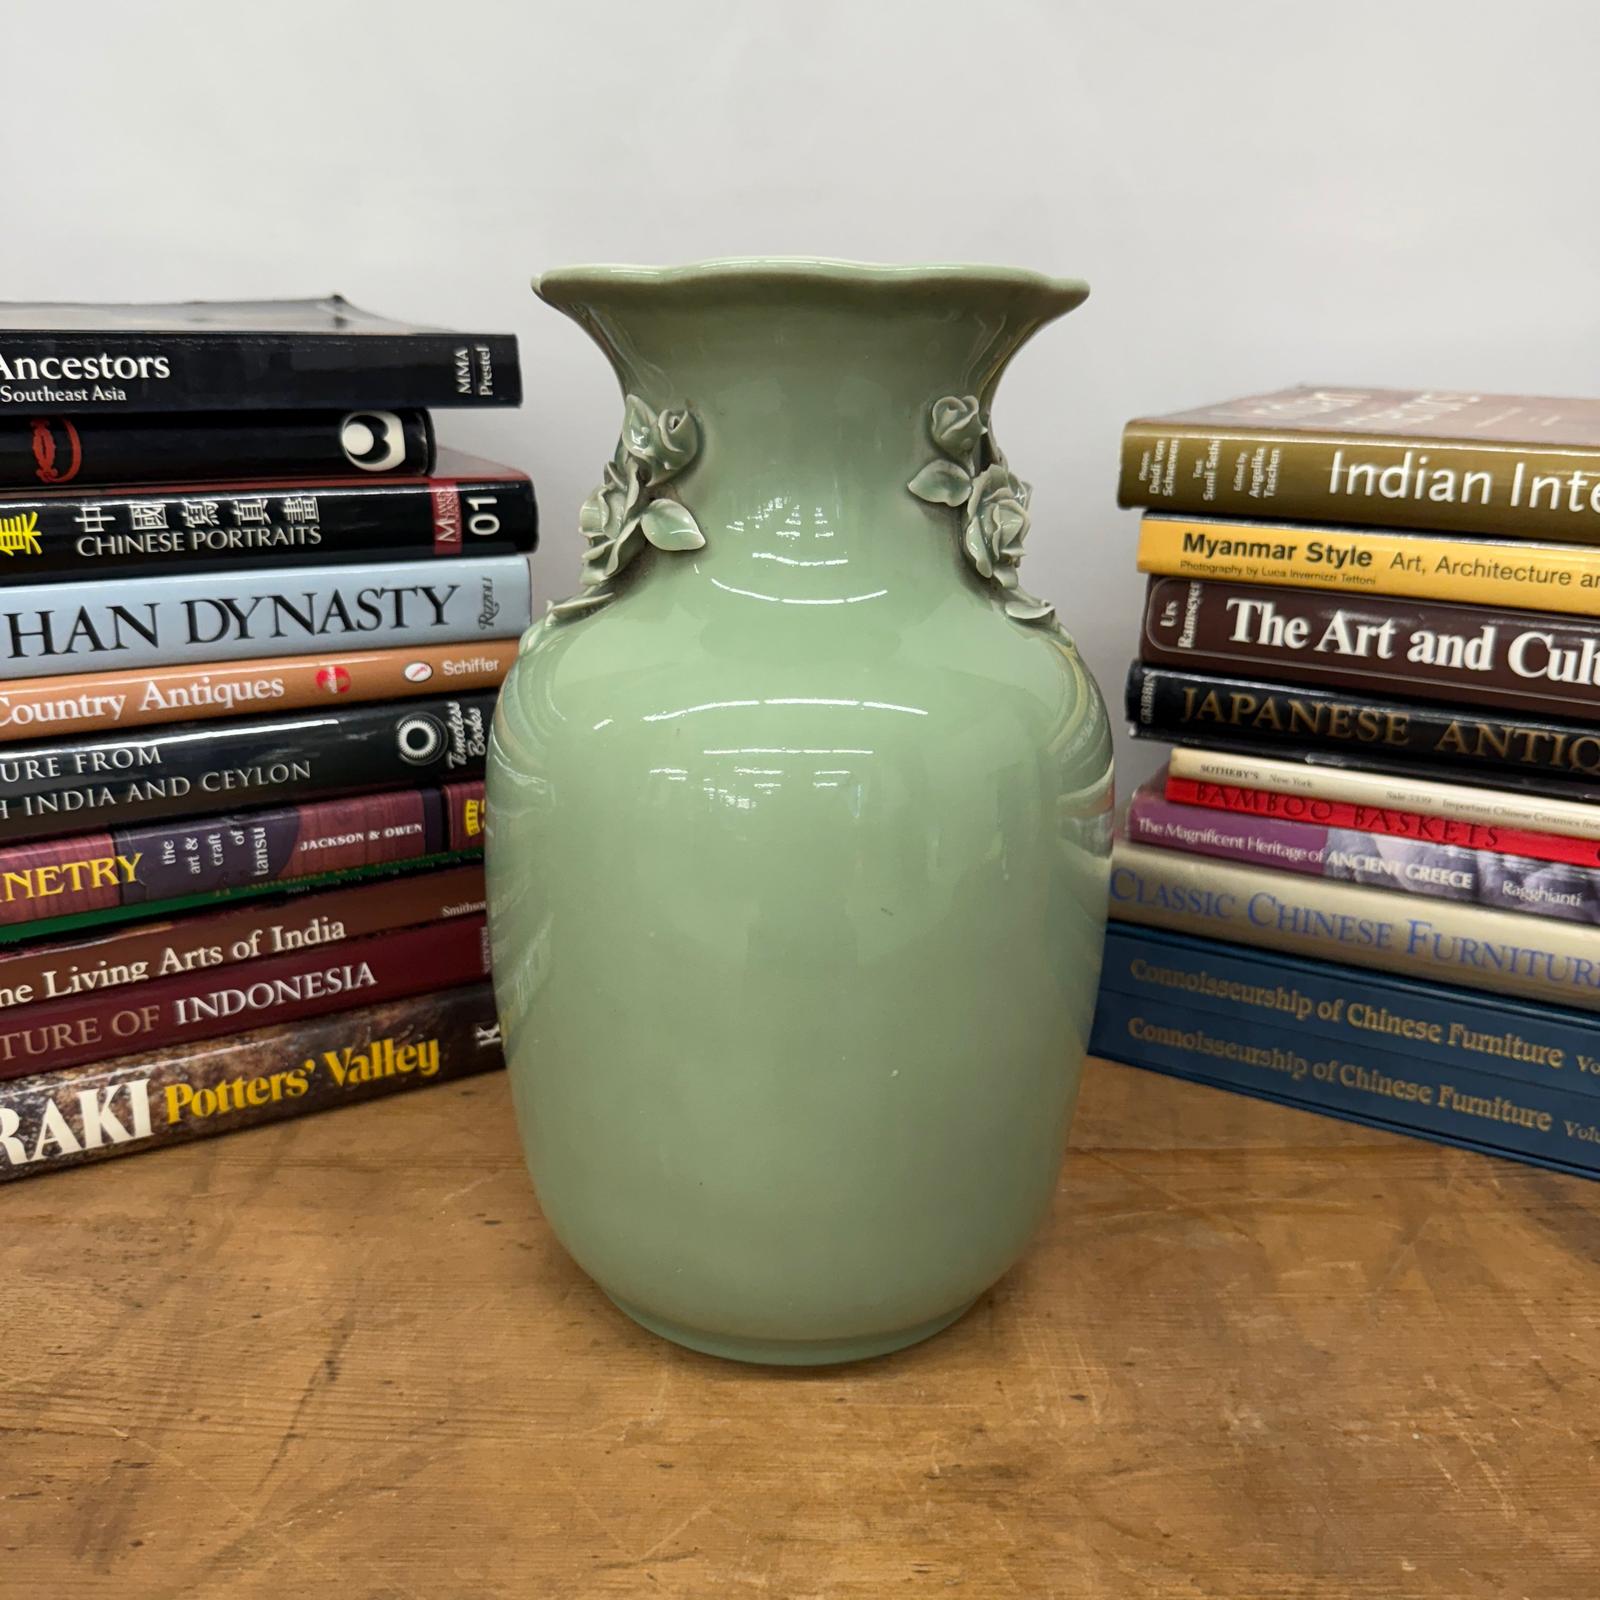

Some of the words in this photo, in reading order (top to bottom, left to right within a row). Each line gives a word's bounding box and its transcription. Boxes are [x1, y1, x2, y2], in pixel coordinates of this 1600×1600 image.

[0, 385, 89, 402] Southeast
[92, 386, 127, 401] Asia
[455, 346, 472, 394] MMA
[475, 345, 493, 396] Prestel
[1206, 438, 1221, 469] Sethi
[1249, 448, 1265, 498] Angelika
[1264, 448, 1280, 498] Taschen
[1329, 450, 1491, 505] Indian
[1203, 471, 1217, 501] Sunil
[466, 496, 500, 536] 01
[77, 531, 185, 557] CHINESE
[193, 525, 322, 552] PORTRAITS
[1183, 533, 1297, 561] Myanmar
[1306, 542, 1372, 570] Style
[1390, 552, 1427, 575] Art,
[1435, 556, 1571, 586] Architecture
[1180, 560, 1243, 576] Photography
[1246, 565, 1258, 576] by
[1262, 568, 1287, 578] Luca
[2, 602, 161, 660] HAN
[181, 584, 461, 645] DYNASTY
[1160, 601, 1178, 627] Urs
[1178, 582, 1202, 648] Ramseyer
[1226, 598, 1310, 650] The
[1314, 610, 1397, 660] Art
[1407, 625, 1497, 671] and
[442, 657, 500, 677] Schiffer
[139, 676, 285, 711] Antiques
[1182, 686, 1409, 746] JAPANESE
[464, 708, 486, 756] Books
[0, 756, 61, 784] URE
[74, 746, 163, 775] FROM
[24, 786, 116, 818] INDIA
[127, 776, 191, 803] AND
[202, 760, 312, 793] CEYLON
[1196, 784, 1333, 820] BAMBOO
[1353, 806, 1499, 848] BASKETS
[1201, 764, 1259, 780] SOTHEBY'S
[1270, 774, 1288, 784] New
[1291, 776, 1313, 788] York
[1443, 799, 1490, 815] Important
[1493, 805, 1531, 819] Chinese
[1534, 812, 1579, 827] Ceramics
[163, 840, 176, 865] the
[185, 838, 198, 851] &
[208, 833, 223, 866] craft
[230, 829, 245, 846] of
[253, 827, 269, 876] tansu
[299, 832, 365, 853] JACKSON
[368, 830, 380, 841] &
[385, 823, 423, 839] OWEN
[1138, 819, 1163, 834] The
[1165, 822, 1245, 849] Magnificent
[1247, 836, 1307, 860] Heritage
[1308, 848, 1325, 862] of
[1326, 851, 1401, 877] ANCIENT
[1405, 863, 1473, 890] GREECE
[2, 853, 144, 902] NETRY
[188, 855, 201, 875] art
[1110, 868, 1236, 920] CLASSIC
[1248, 892, 1393, 949] CHINESE
[1502, 880, 1583, 907] Ragghianti
[43, 960, 149, 1001] Living
[159, 945, 223, 976] Arts
[232, 929, 262, 960] of
[272, 916, 347, 953] India
[0, 1017, 102, 1061] TURE
[111, 1004, 160, 1037] OF
[175, 961, 378, 1027] INDONESIA
[1130, 958, 1312, 1020] Connoisseurship
[1317, 998, 1344, 1022] of
[1347, 1002, 1442, 1044] Chinese
[1448, 1022, 1565, 1068] Furniture
[164, 1059, 315, 1126] Potters'
[323, 1037, 440, 1087] Valley
[1128, 1017, 1306, 1080] Connoisseurship
[1313, 1060, 1338, 1083] of
[1340, 1065, 1432, 1105] Chinese
[1437, 1084, 1553, 1132] Furniture
